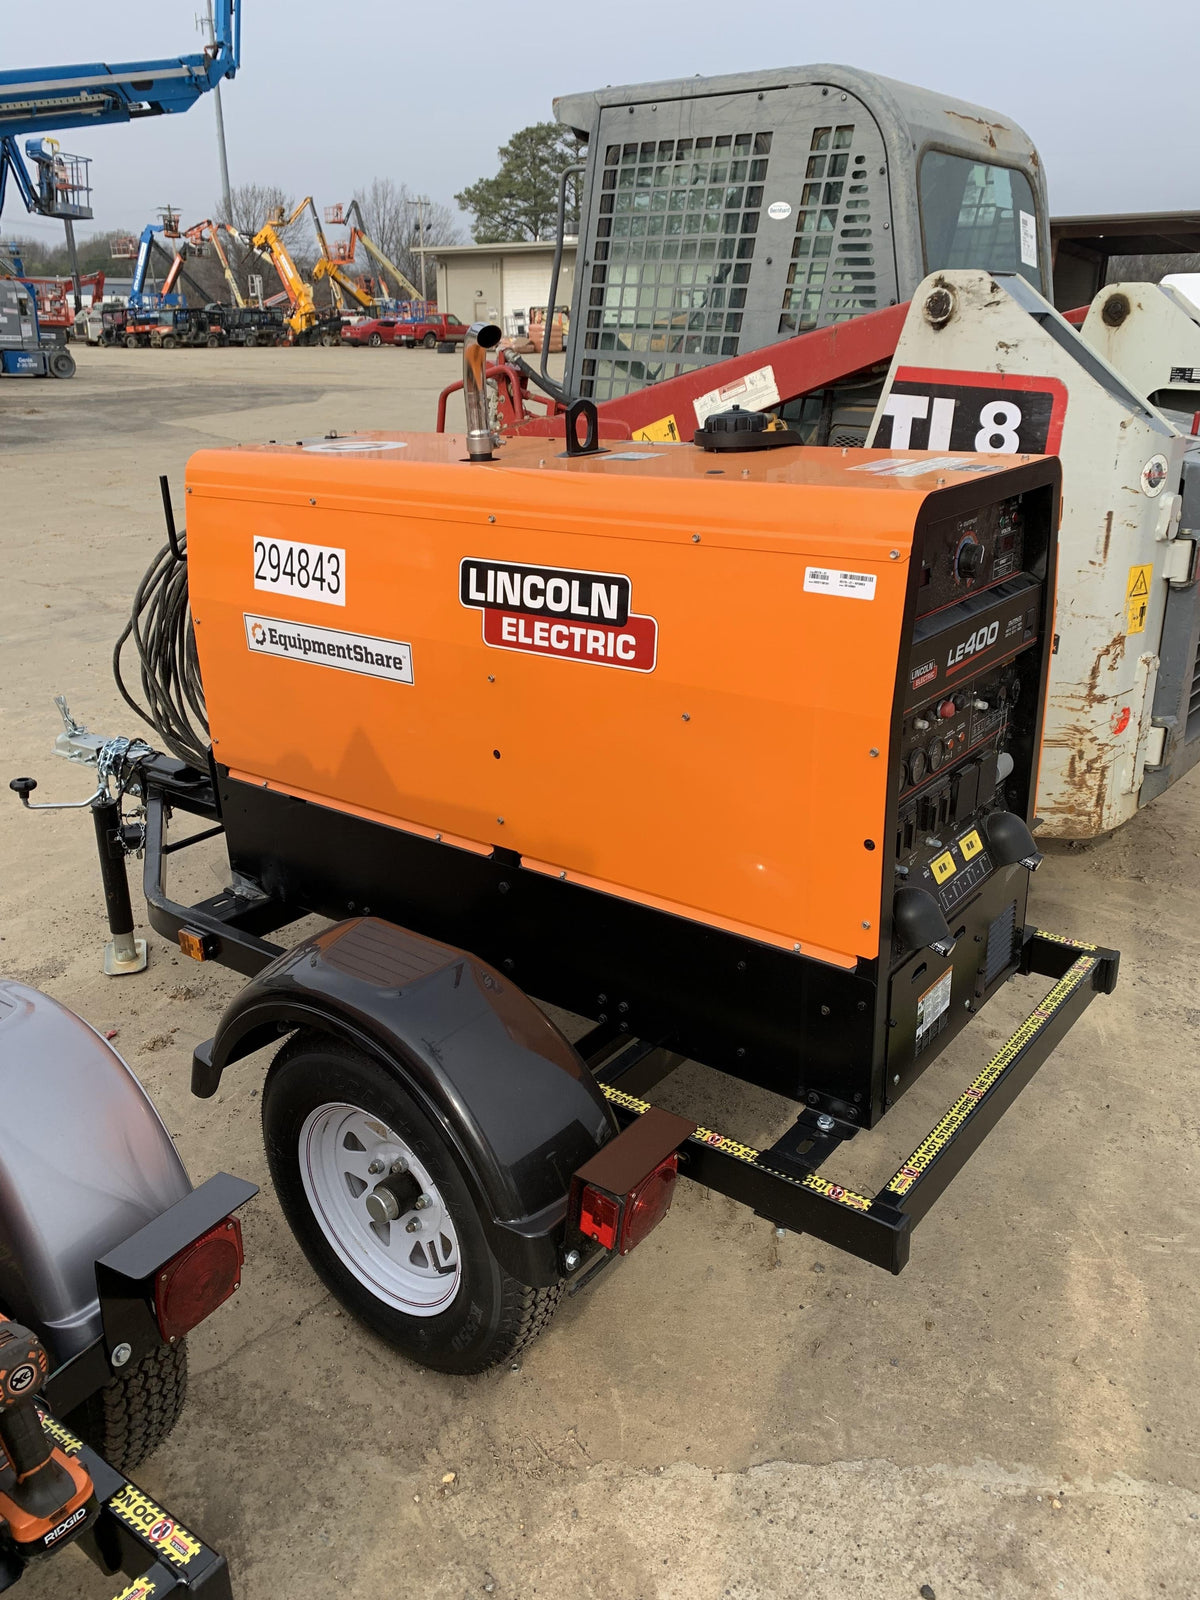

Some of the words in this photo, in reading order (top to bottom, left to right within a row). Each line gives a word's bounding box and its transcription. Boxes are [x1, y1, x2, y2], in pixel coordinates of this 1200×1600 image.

[254, 541, 341, 594] 294843
[469, 567, 619, 620] LINCOLN
[268, 627, 404, 671] EquipmentShare
[502, 616, 636, 660] ELECTRIC
[947, 620, 1000, 667] LE400
[911, 661, 935, 680] LINCOLN
[976, 1079, 988, 1090] NE
[984, 1067, 998, 1080] PAS
[994, 1048, 1014, 1067] TENEZ
[1010, 1025, 1034, 1049] DEBOUT
[1030, 1017, 1041, 1027] ICI
[609, 1092, 642, 1109] TENEZ
[722, 1142, 741, 1153] NO
[913, 1156, 926, 1168] DO
[926, 1140, 940, 1156] NOT
[936, 1116, 958, 1140] STAND
[957, 1096, 975, 1116] HERE
[44, 1508, 87, 1545] RIDGID
[132, 1504, 158, 1526] DO
